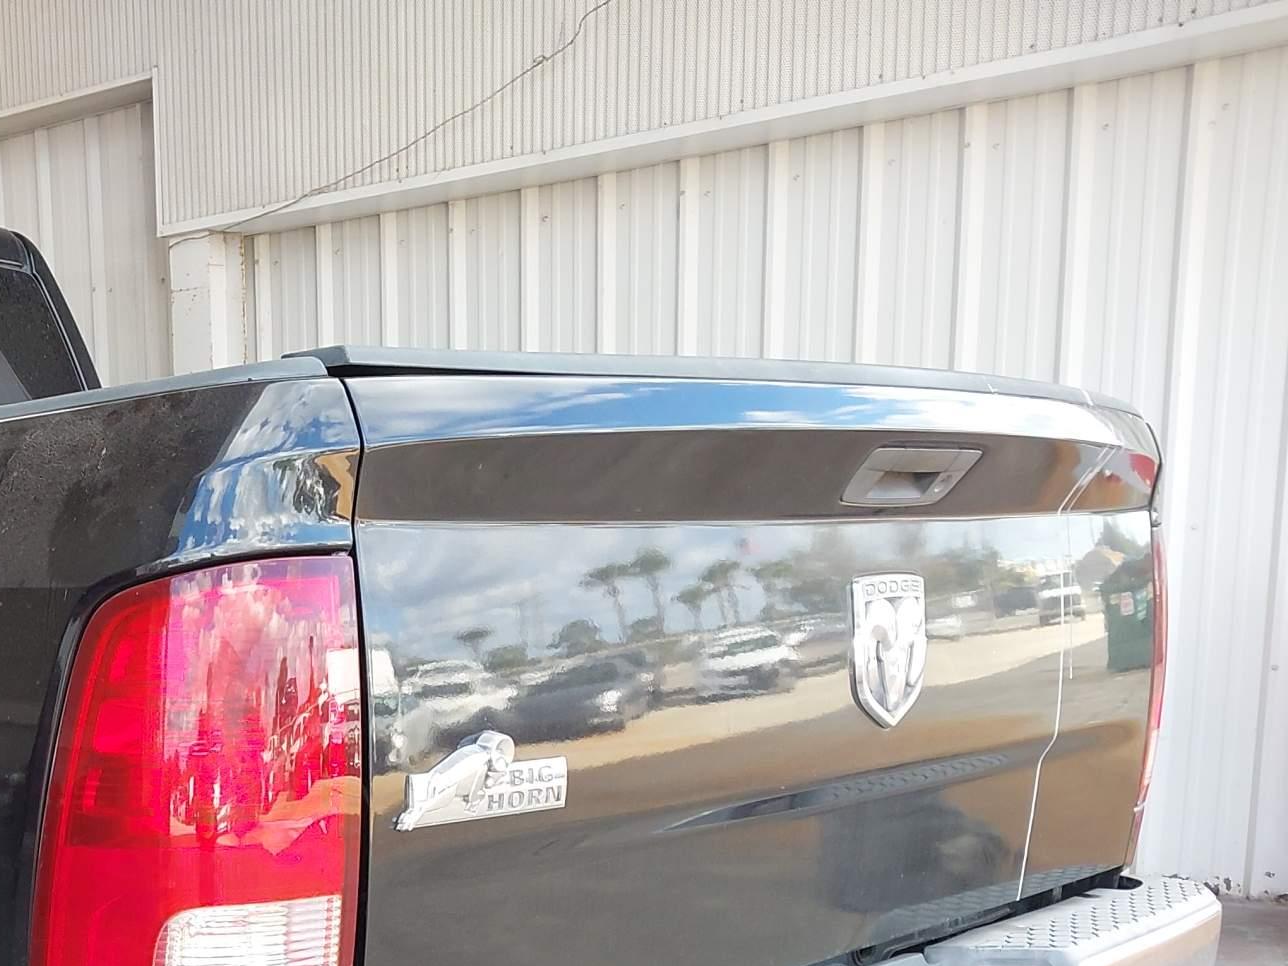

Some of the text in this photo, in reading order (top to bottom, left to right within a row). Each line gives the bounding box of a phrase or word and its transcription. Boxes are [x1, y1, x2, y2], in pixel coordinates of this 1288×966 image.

[864, 579, 920, 596] DODGE
[509, 765, 553, 787] BIG
[487, 785, 562, 811] HORN
